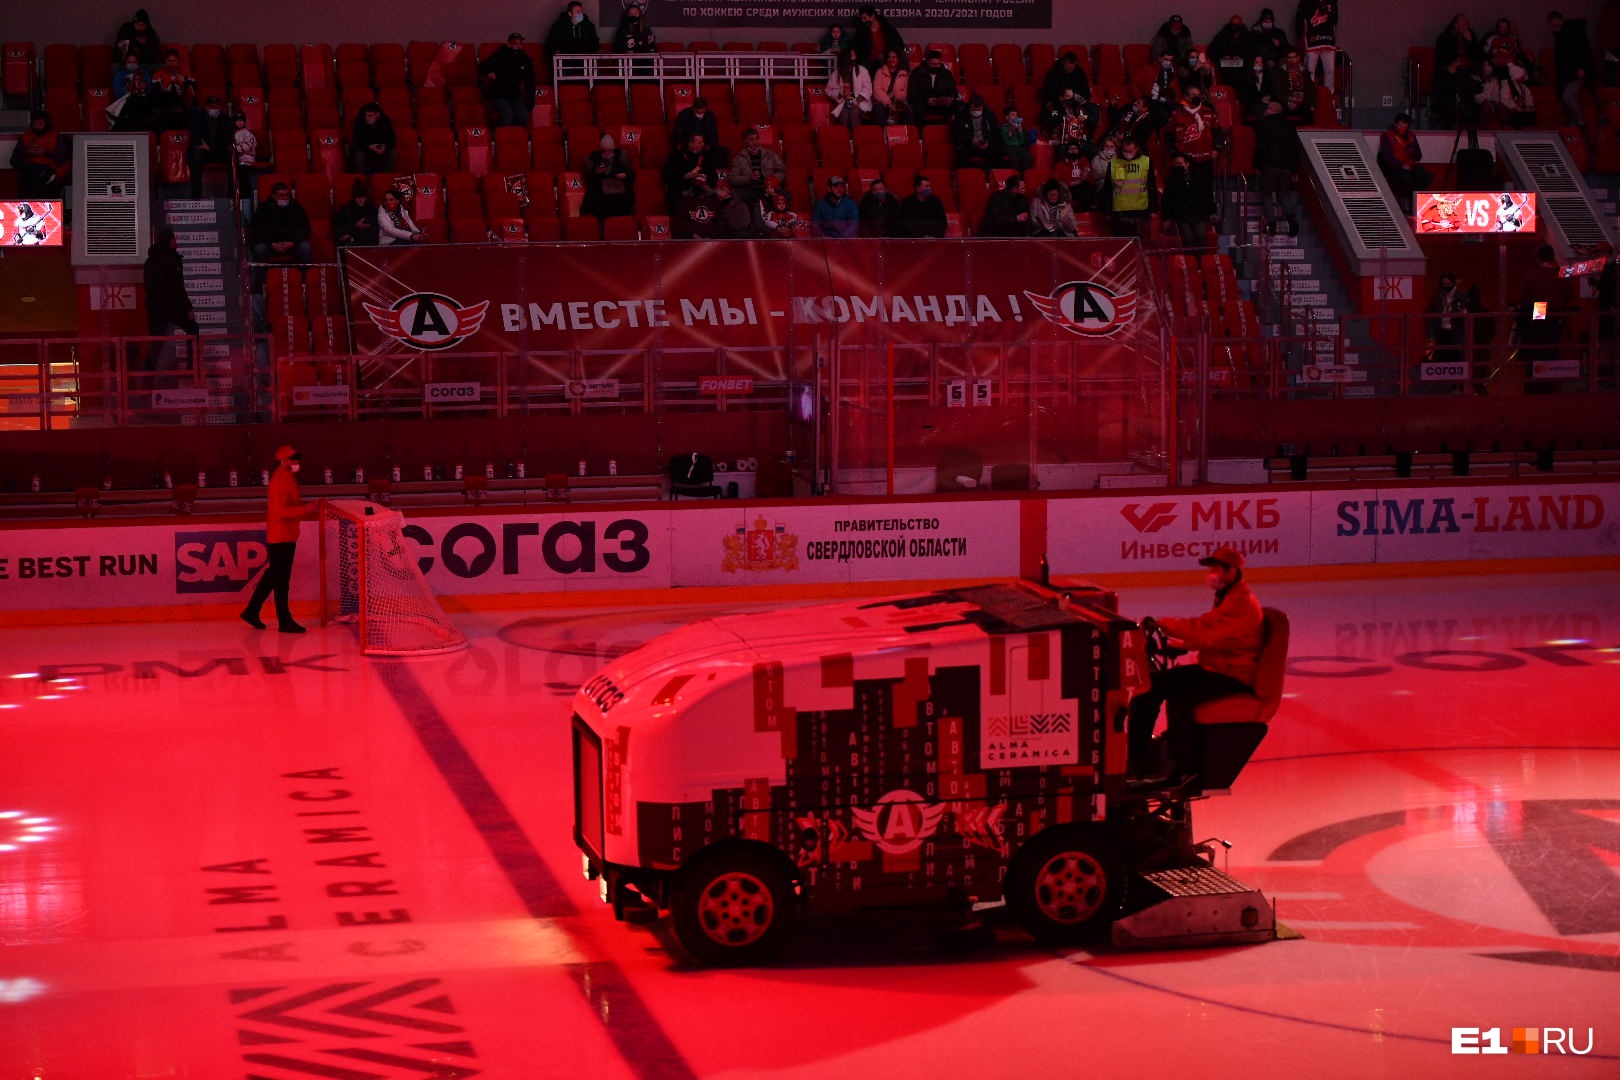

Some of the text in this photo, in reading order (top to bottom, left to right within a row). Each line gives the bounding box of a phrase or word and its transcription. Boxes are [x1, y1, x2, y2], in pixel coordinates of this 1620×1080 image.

[683, 8, 697, 17] ПО
[700, 8, 743, 17] ХОККЕЮ
[746, 8, 780, 18] СРЕДИ
[783, 8, 834, 17] МУЖСКИХ
[884, 9, 922, 18] СЕЗОНА
[924, 8, 978, 19] 2020/2021
[981, 9, 1013, 19] ГОДОВ
[1465, 199, 1490, 227] VS
[501, 299, 670, 332] ВМЕСТЕ
[679, 298, 758, 327] МЫ
[792, 295, 1002, 327] КОМАНДА
[699, 379, 752, 391] FONBET
[977, 384, 988, 399] 5
[834, 517, 940, 533] ПРАВИТЕЛЬСТВО
[1189, 498, 1281, 532] МКБ
[1336, 494, 1605, 537] SIMA-LAND
[178, 540, 269, 583] SAP
[806, 535, 967, 562] СВЕРДЛОВСКОЙ ОБЛАСТИ
[19, 555, 91, 579] BEST
[100, 554, 158, 577] RUN
[988, 741, 1029, 750] ALMA
[988, 749, 1070, 761] CERAMICA
[200, 858, 299, 962] ALMA
